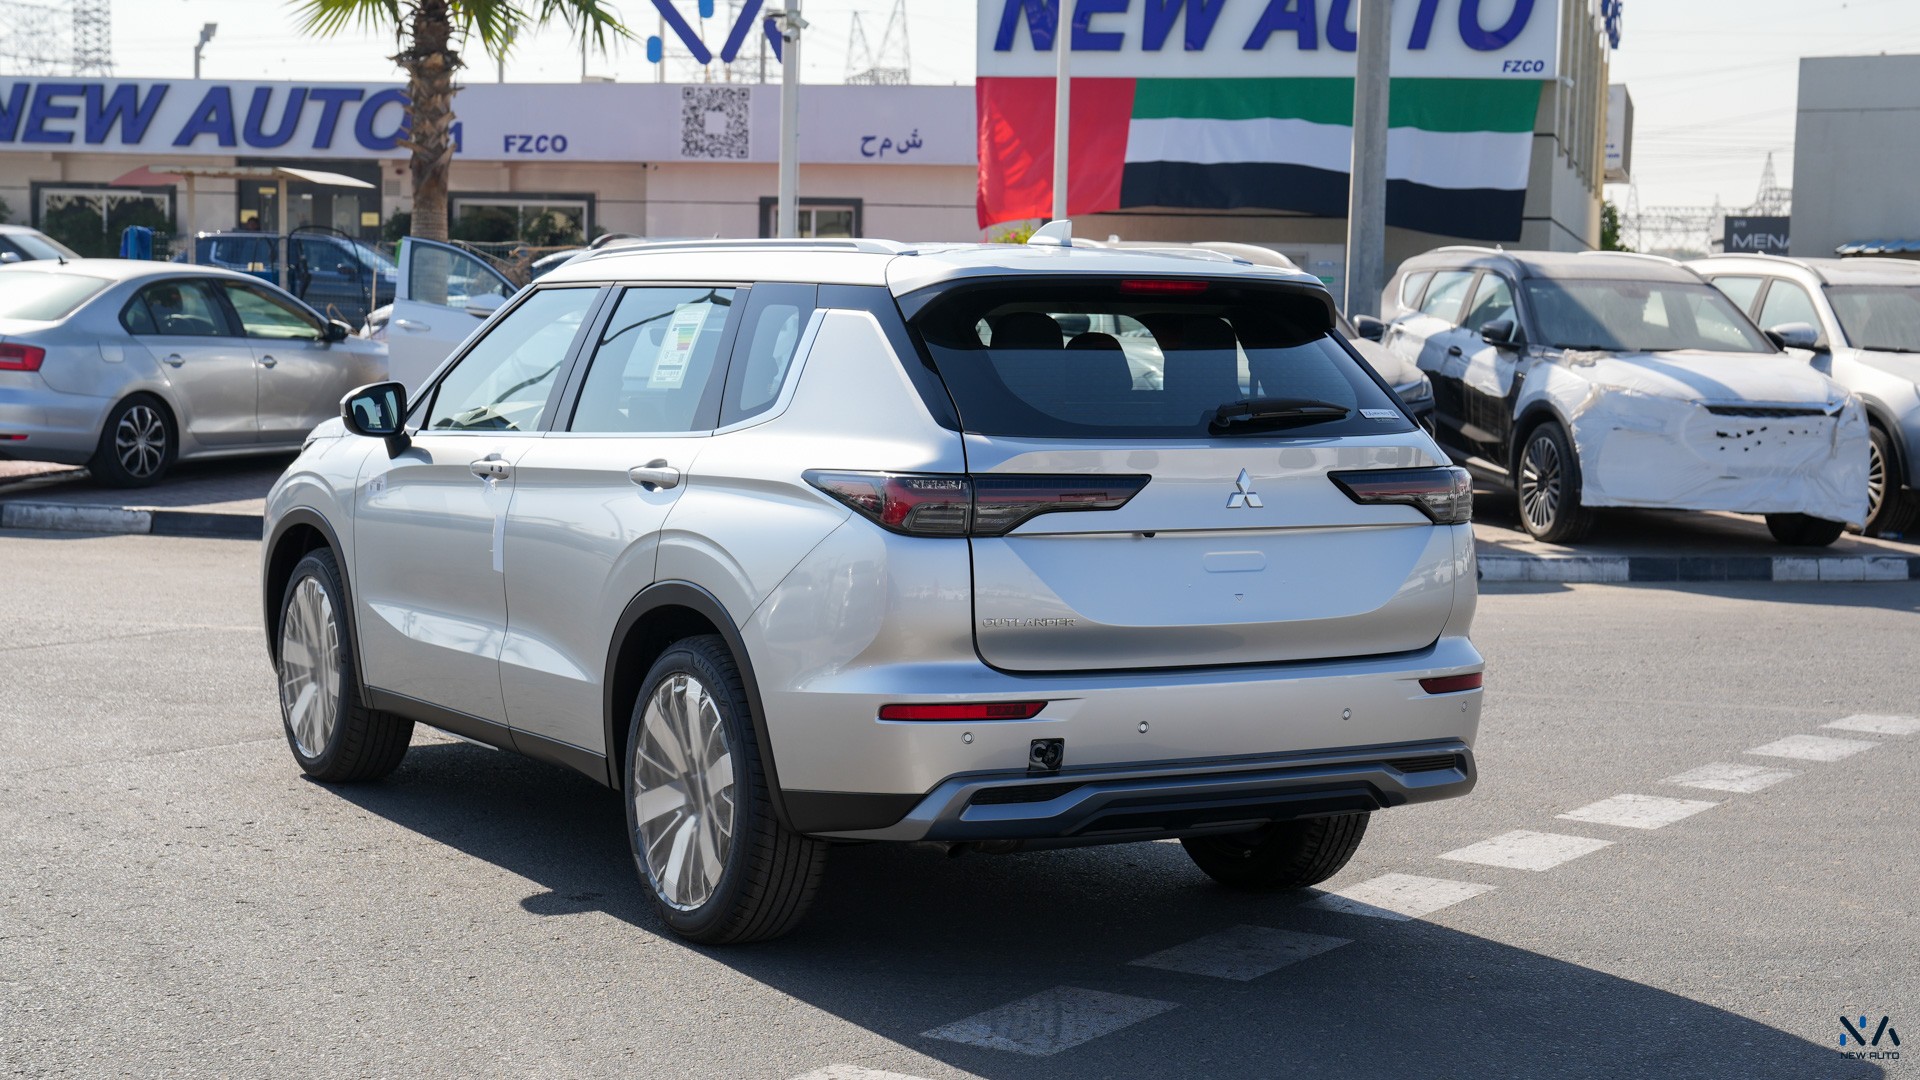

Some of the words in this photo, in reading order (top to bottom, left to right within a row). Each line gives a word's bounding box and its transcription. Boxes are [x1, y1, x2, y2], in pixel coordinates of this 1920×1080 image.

[1502, 60, 1545, 73] FZCO
[172, 86, 414, 151] AUTO
[504, 135, 567, 153] FZCO
[982, 618, 1077, 628] OUTLANDER
